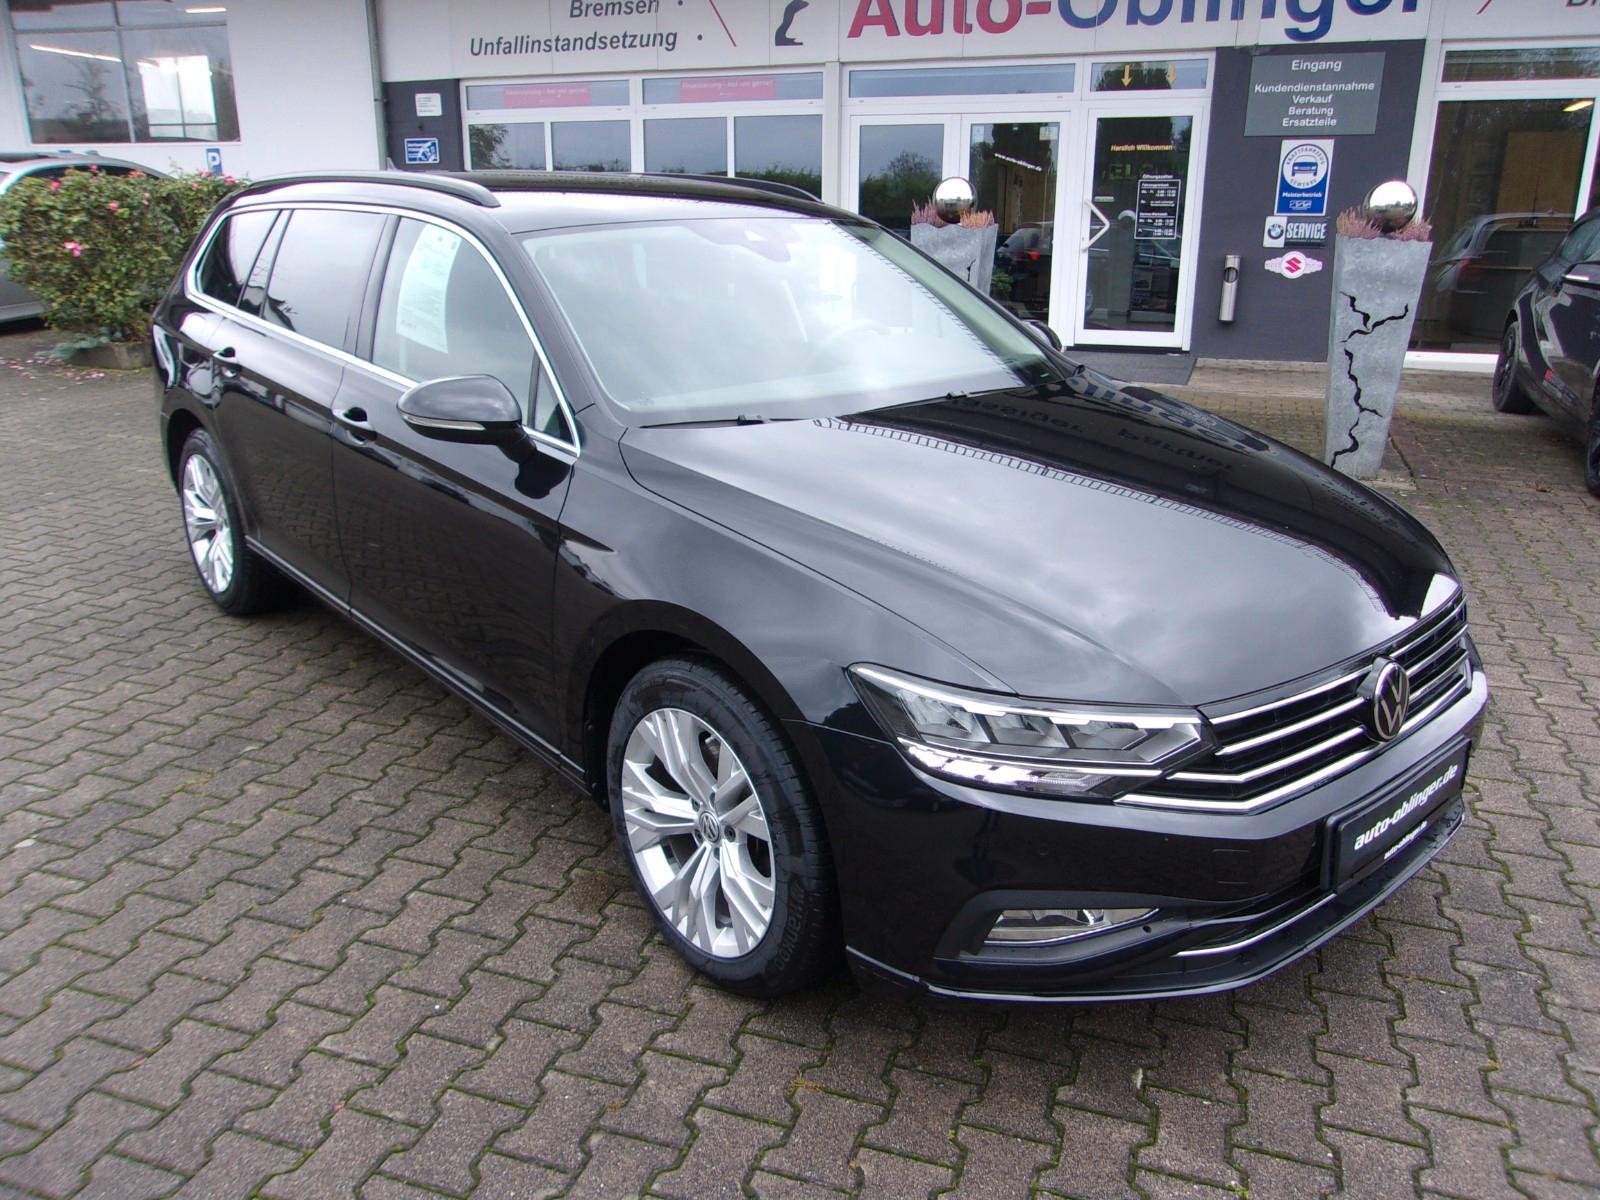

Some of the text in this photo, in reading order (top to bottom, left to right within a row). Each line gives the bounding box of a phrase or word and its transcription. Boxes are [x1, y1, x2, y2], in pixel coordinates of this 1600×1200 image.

[569, 0, 660, 18] Bremsen
[470, 31, 678, 57] Unfallinstandsetzung
[1291, 59, 1342, 72] Eingang
[1254, 81, 1375, 93] Kundendienstannahme
[1292, 94, 1333, 104] Verkauf
[1288, 106, 1334, 117] Beratung
[1282, 117, 1337, 127] Ersatzteile
[1286, 222, 1328, 239] SERVICE
[1354, 764, 1458, 850] auto-oblinger.de
